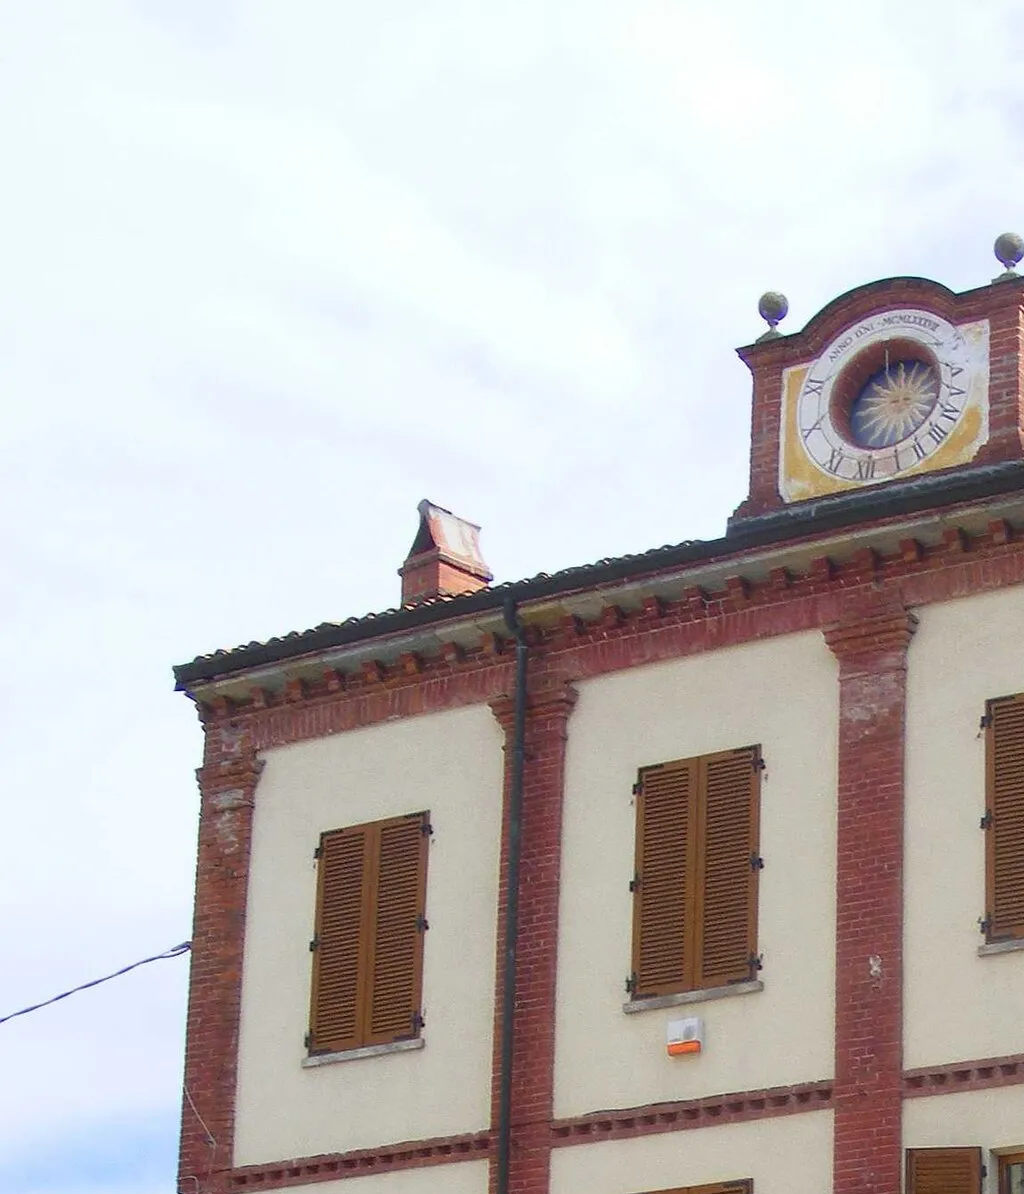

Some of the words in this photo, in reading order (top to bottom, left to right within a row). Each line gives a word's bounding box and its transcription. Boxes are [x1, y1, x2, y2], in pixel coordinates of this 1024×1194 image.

[828, 336, 854, 362] ANNO
[801, 419, 822, 439] X
[913, 442, 927, 461] II
[852, 459, 876, 480] XII
